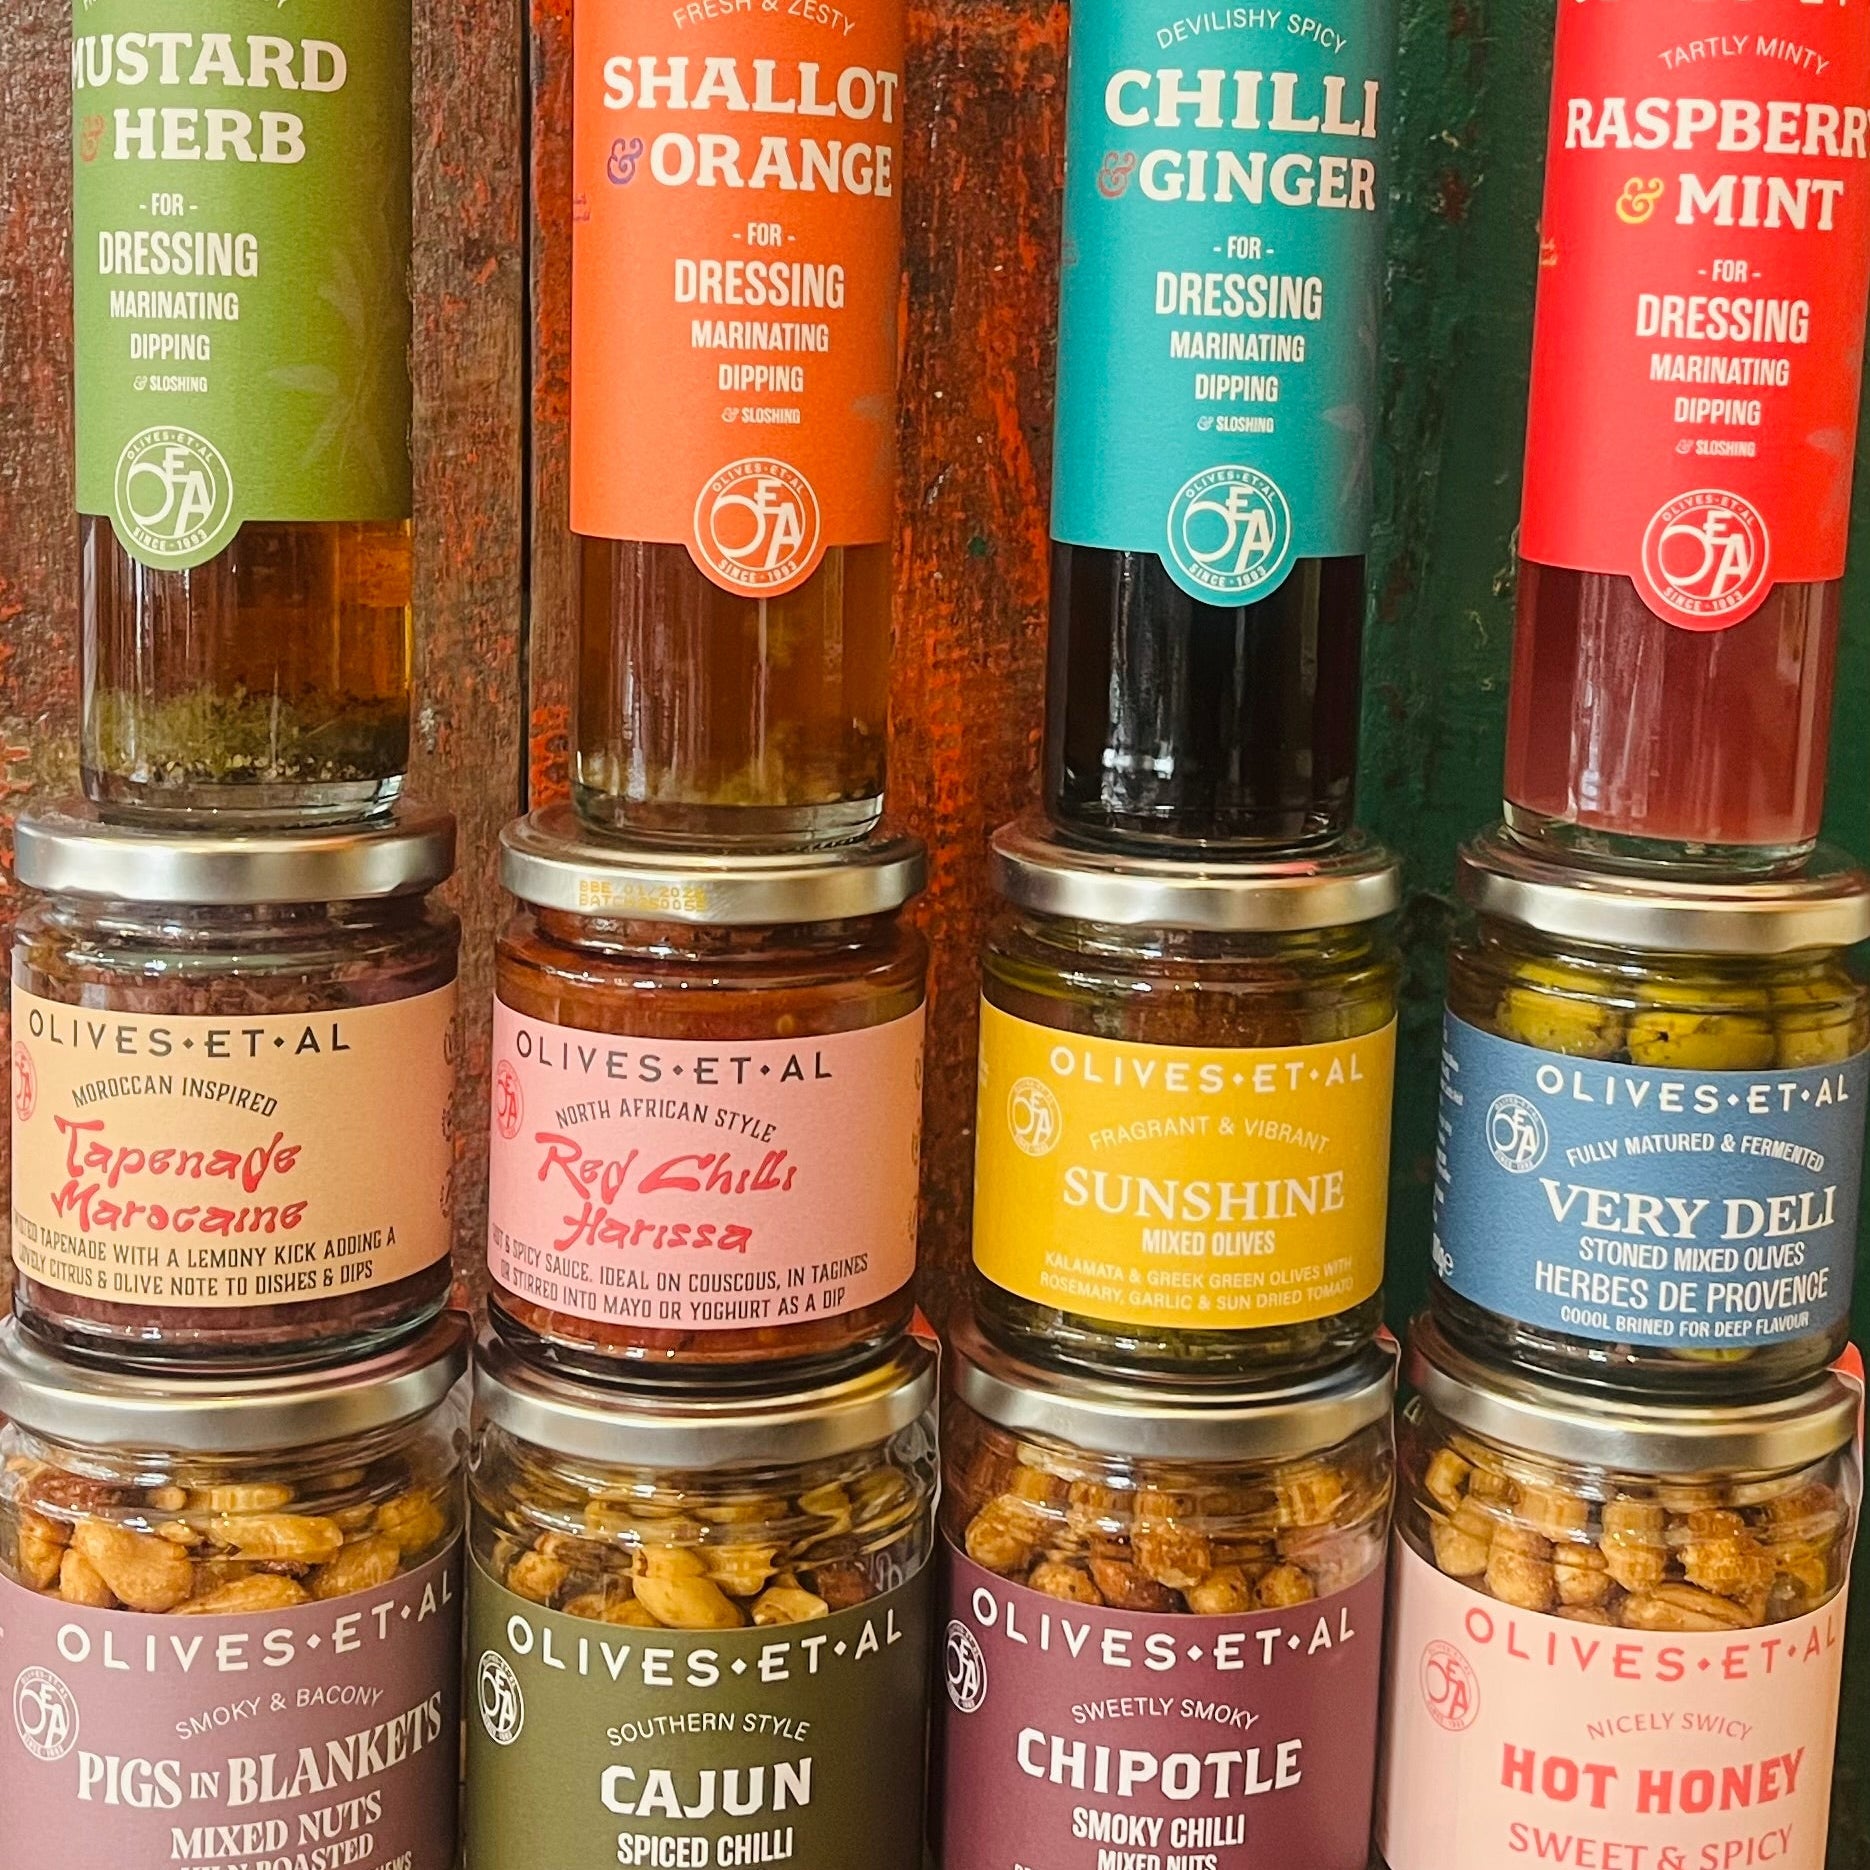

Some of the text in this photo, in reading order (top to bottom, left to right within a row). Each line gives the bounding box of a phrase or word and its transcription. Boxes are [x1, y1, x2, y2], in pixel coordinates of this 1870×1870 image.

[672, 0, 751, 30] FRESH
[788, 0, 855, 37] ZESTY
[1156, 8, 1347, 54] DEVILISHY SPICY
[72, 32, 347, 92] MUSTARD
[1658, 34, 1830, 76] TARTLY MINTY
[603, 56, 898, 123] SHALLOT
[1105, 68, 1379, 139] CHILLI
[113, 108, 306, 164] HERB
[1564, 97, 1870, 159] RASPBERR
[607, 132, 892, 197] & ORANGE
[1098, 149, 1375, 211] & GINGER
[1615, 173, 1844, 231] & MINT
[99, 231, 258, 278] DRESSING
[110, 291, 239, 321] MARINATING
[674, 258, 845, 309] DRESSING
[1155, 271, 1323, 320] DRESSING
[691, 320, 829, 352] MARINATING
[1635, 293, 1809, 344] DRESSING
[130, 334, 210, 361] DIPPING
[1170, 331, 1305, 363] MARINATING
[1650, 353, 1790, 387] MARINATING
[150, 376, 207, 393] SLOSHING
[719, 364, 804, 392] DIPPING
[1195, 374, 1279, 402] DIPPING
[741, 408, 801, 424] SLOSHING
[1216, 416, 1274, 433] SLOSHING
[1674, 396, 1762, 426] DIPPING
[1695, 439, 1756, 458] SLOSHING
[71, 1075, 278, 1117] MOROCCAN INSPIRED
[555, 1098, 777, 1144] NORTH AFRICAN STYLE
[1089, 1116, 1330, 1155] FRAGRANT & VIBRANT
[54, 1115, 302, 1193] Tapenade
[535, 1131, 798, 1205] Red Chilli
[1566, 1132, 1825, 1173] FULLY MATURED & FERMENTED
[51, 1179, 308, 1237] Marocaine
[1063, 1166, 1345, 1222] SUNSHINE
[1539, 1177, 1837, 1240] VERY DELI
[40, 1226, 396, 1268] TAPENADE WITH A LEMONY KICK ADDING A
[553, 1201, 753, 1253] Harissa
[1142, 1228, 1275, 1257] MIXED OLIVES
[50, 1258, 373, 1296] CITRUS & OLIVE NOTE TO DISHES & DIPS
[512, 1240, 541, 1269] SPICY
[600, 1266, 649, 1291] IDEAL
[657, 1272, 681, 1292] ON
[688, 1271, 780, 1293] COUSCOUS,
[787, 1267, 804, 1288] IN
[812, 1253, 868, 1284] TAGINES
[1045, 1251, 1352, 1289] KALAMATA & GREEK GREEN OLIVES WITH
[1579, 1236, 1806, 1273] STONED MIXED OLIVES
[513, 1267, 845, 1321] STIRRED INTO MAYO OR YOGHURT AS A DIP
[1040, 1271, 1354, 1311] ROSEMARY, GARLIC & SUN DRIED TOMATO
[1535, 1260, 1831, 1314] HERBES DE PROVENCE
[1616, 1315, 1674, 1336] BRINED
[1679, 1320, 1710, 1338] FOR
[1714, 1320, 1752, 1337] DEEP
[1755, 1311, 1809, 1336] FLAVOUR
[175, 1685, 383, 1740] SMOKY & BACONY
[607, 1712, 811, 1746] SOUTHERN STYLE
[1071, 1697, 1260, 1731] SWEETLY SMOKY
[1586, 1712, 1753, 1741] NICELY SWICY
[77, 1691, 441, 1809] PIGS IN BLANKETS
[1016, 1726, 1303, 1801] CHIPOTLE
[601, 1757, 812, 1819] CAJUN
[1500, 1742, 1805, 1815] HOT HONEY
[170, 1790, 382, 1860] MIXED NUTS
[617, 1826, 794, 1869] SPICED CHILLI
[1071, 1806, 1245, 1848] SMOKY CHILLI
[1508, 1822, 1793, 1870] SWEET & SPICY
